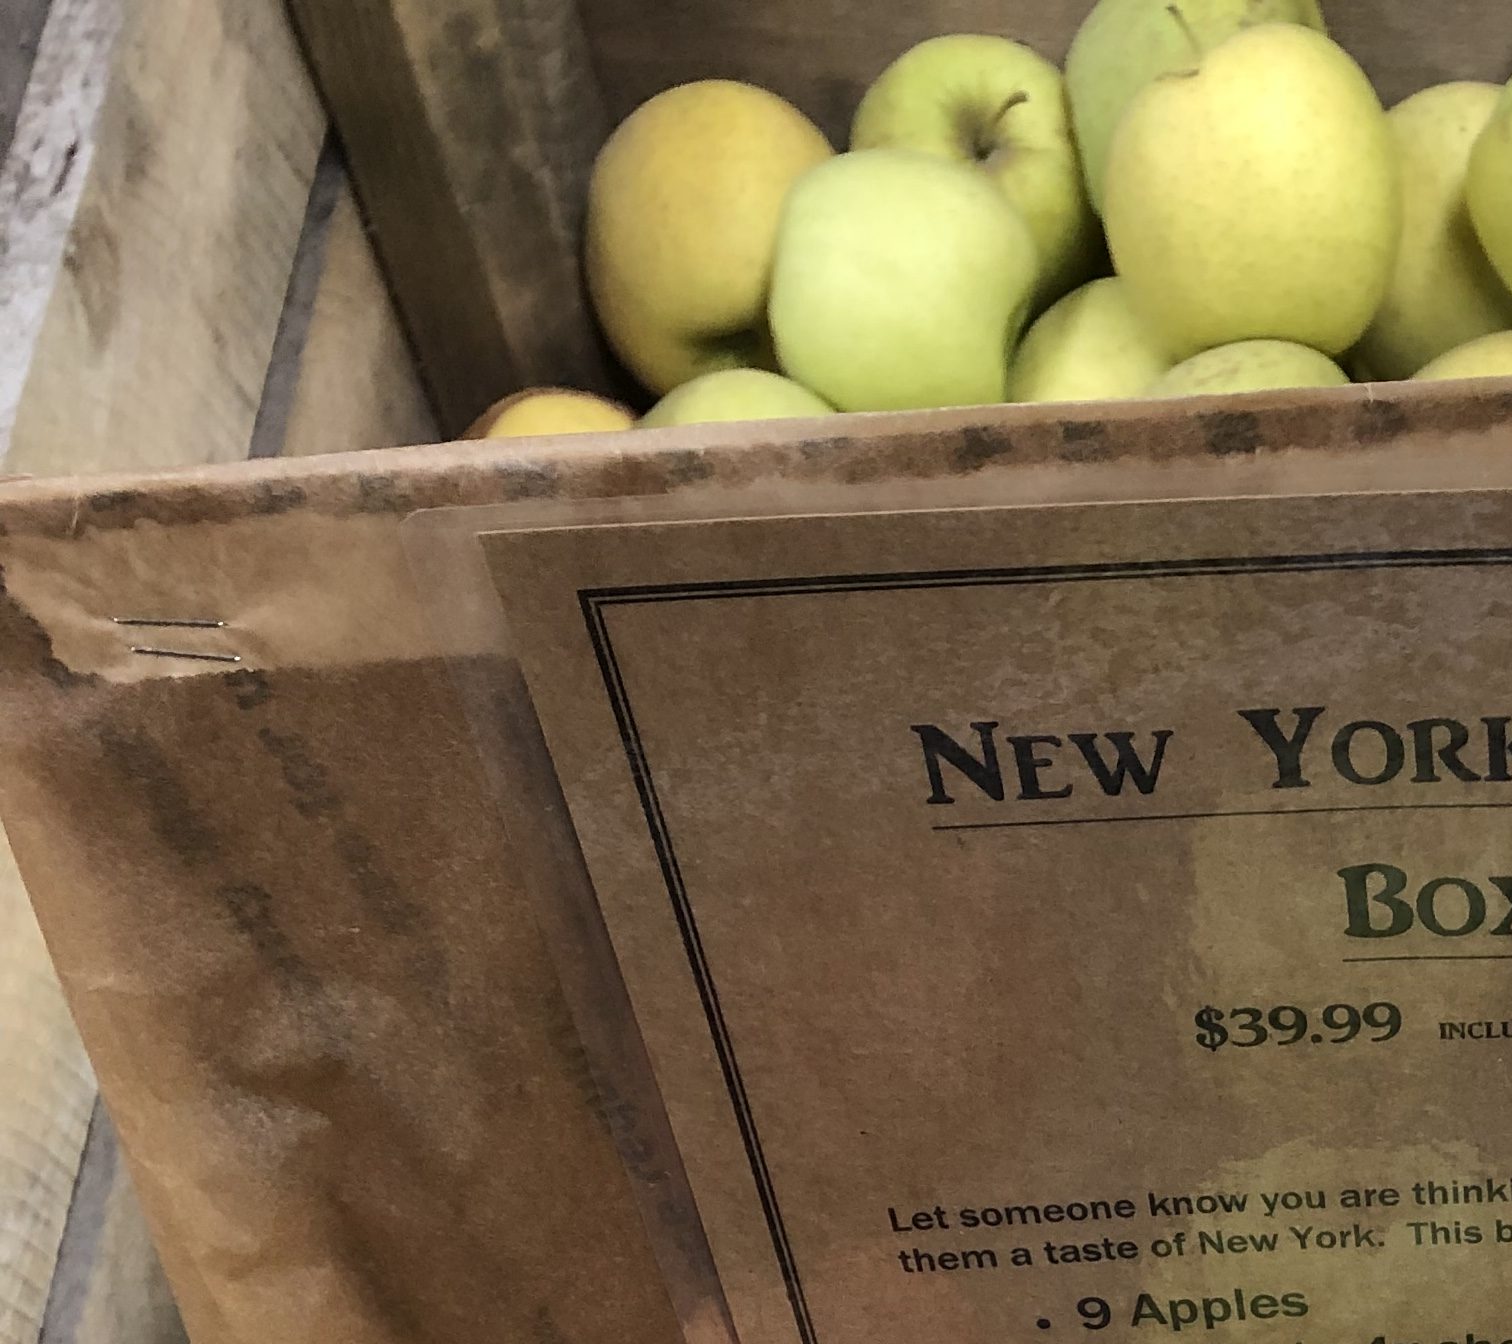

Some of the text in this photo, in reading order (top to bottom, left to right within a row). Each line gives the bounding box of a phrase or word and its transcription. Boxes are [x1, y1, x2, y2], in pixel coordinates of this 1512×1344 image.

[1195, 1001, 1402, 1050] $39.99
[887, 1204, 950, 1233] Let
[959, 1199, 1136, 1228] someone
[1148, 1191, 1248, 1218] know
[1260, 1188, 1326, 1217] you
[1340, 1184, 1400, 1208] are
[898, 1248, 998, 1273] them
[1010, 1246, 1032, 1267] a
[1043, 1237, 1139, 1265] taste
[1151, 1232, 1187, 1258] of
[1199, 1228, 1278, 1256] New
[1290, 1223, 1386, 1251] York.
[1406, 1219, 1482, 1246] This
[1076, 1288, 1310, 1332] 9 Apples
